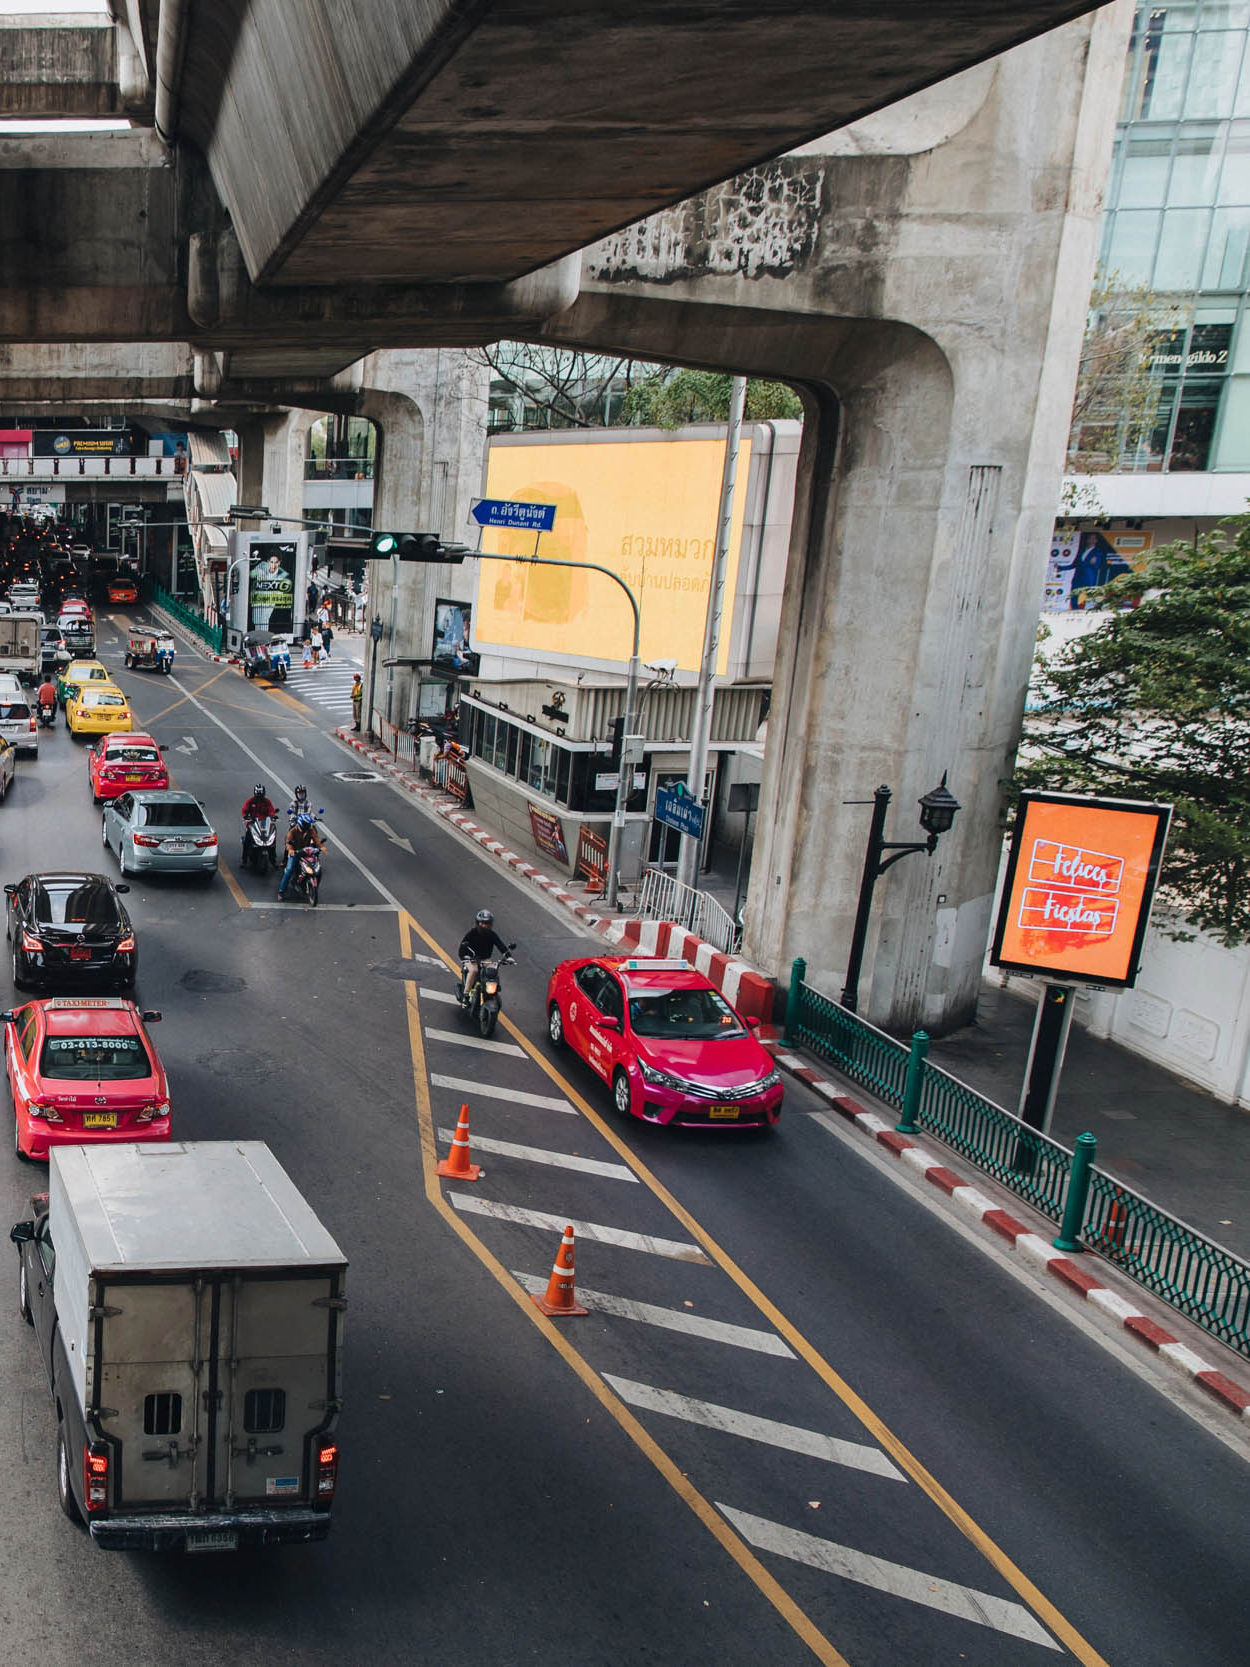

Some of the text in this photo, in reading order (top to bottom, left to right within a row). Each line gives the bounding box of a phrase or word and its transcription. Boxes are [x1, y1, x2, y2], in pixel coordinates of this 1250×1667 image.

[489, 517, 506, 525] Henri
[1054, 853, 1108, 882] Felices
[1044, 899, 1101, 925] Fiestas
[60, 1041, 129, 1050] 02-613-8000
